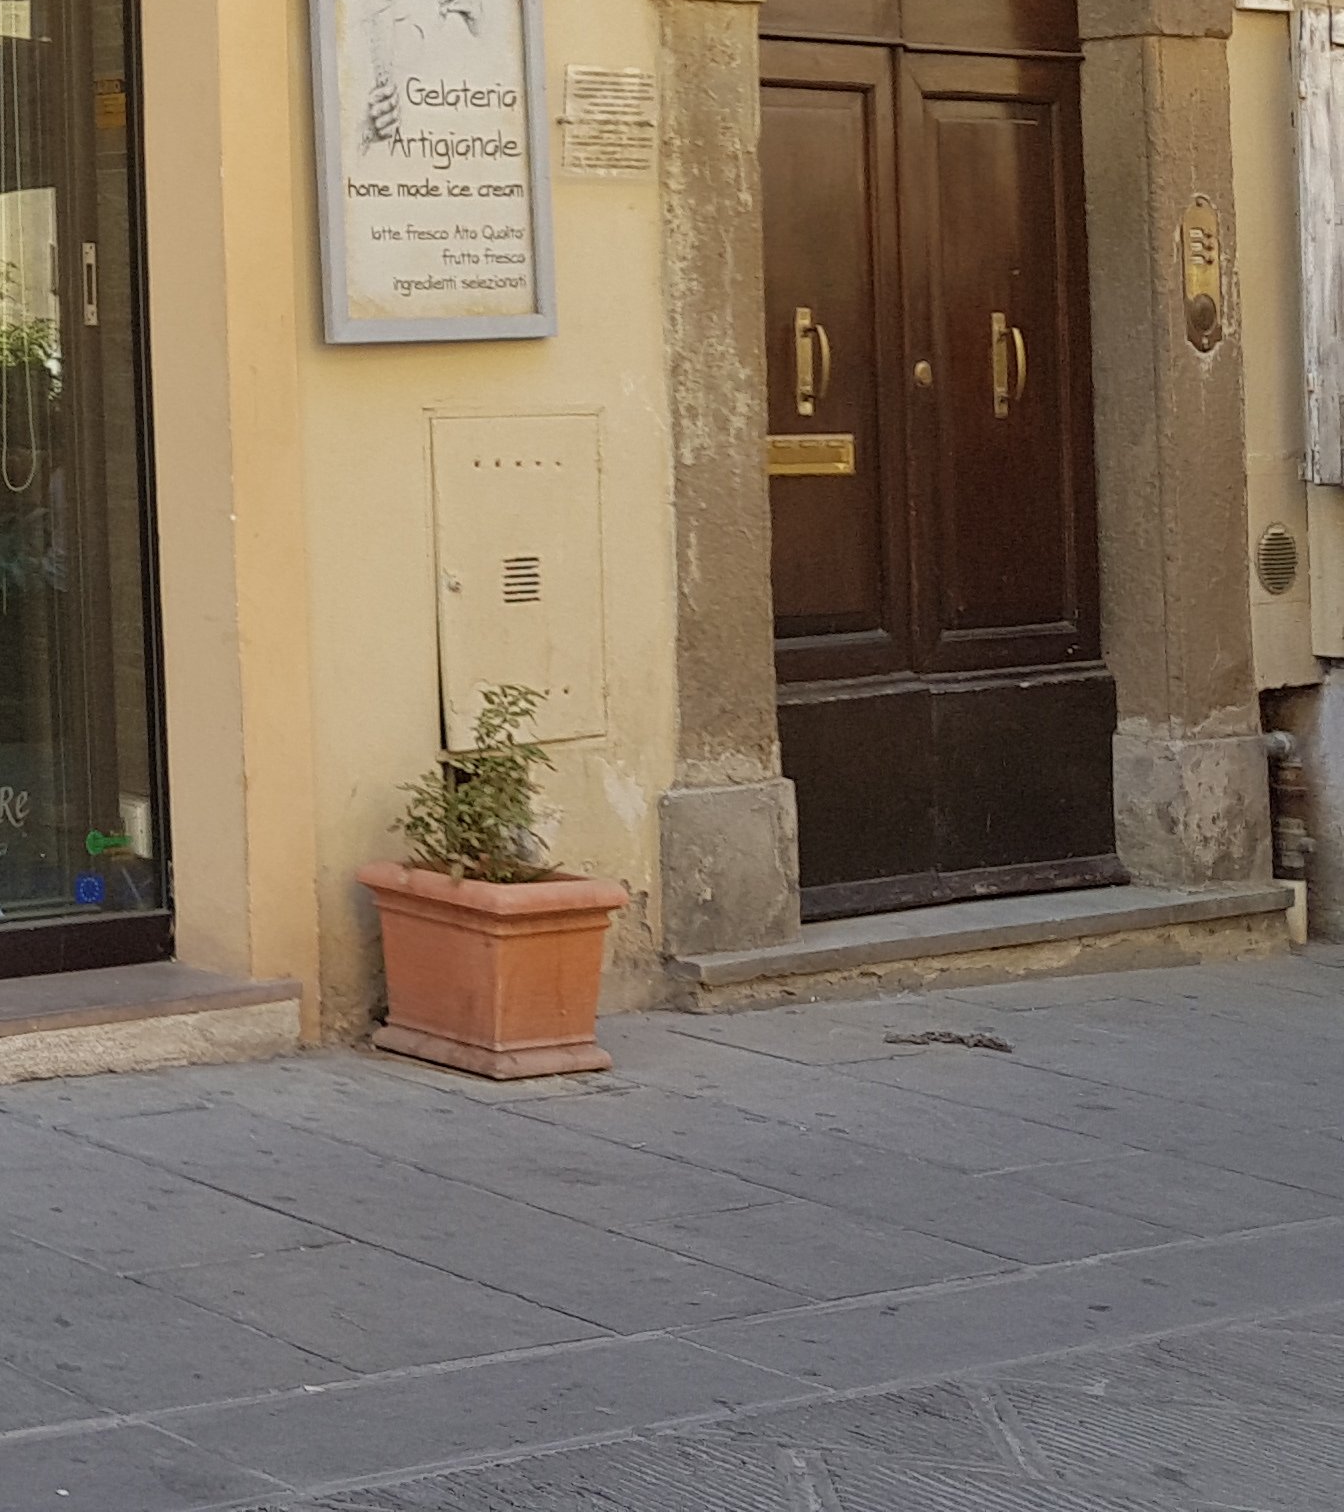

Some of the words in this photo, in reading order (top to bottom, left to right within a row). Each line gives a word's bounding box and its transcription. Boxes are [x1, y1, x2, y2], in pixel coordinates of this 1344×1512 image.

[406, 77, 517, 111] Gelateria
[391, 128, 521, 169] Artigianale
[347, 177, 392, 198] home
[398, 178, 442, 198] made
[447, 180, 472, 197] ice
[478, 184, 524, 197] cream
[406, 224, 449, 240] fresco
